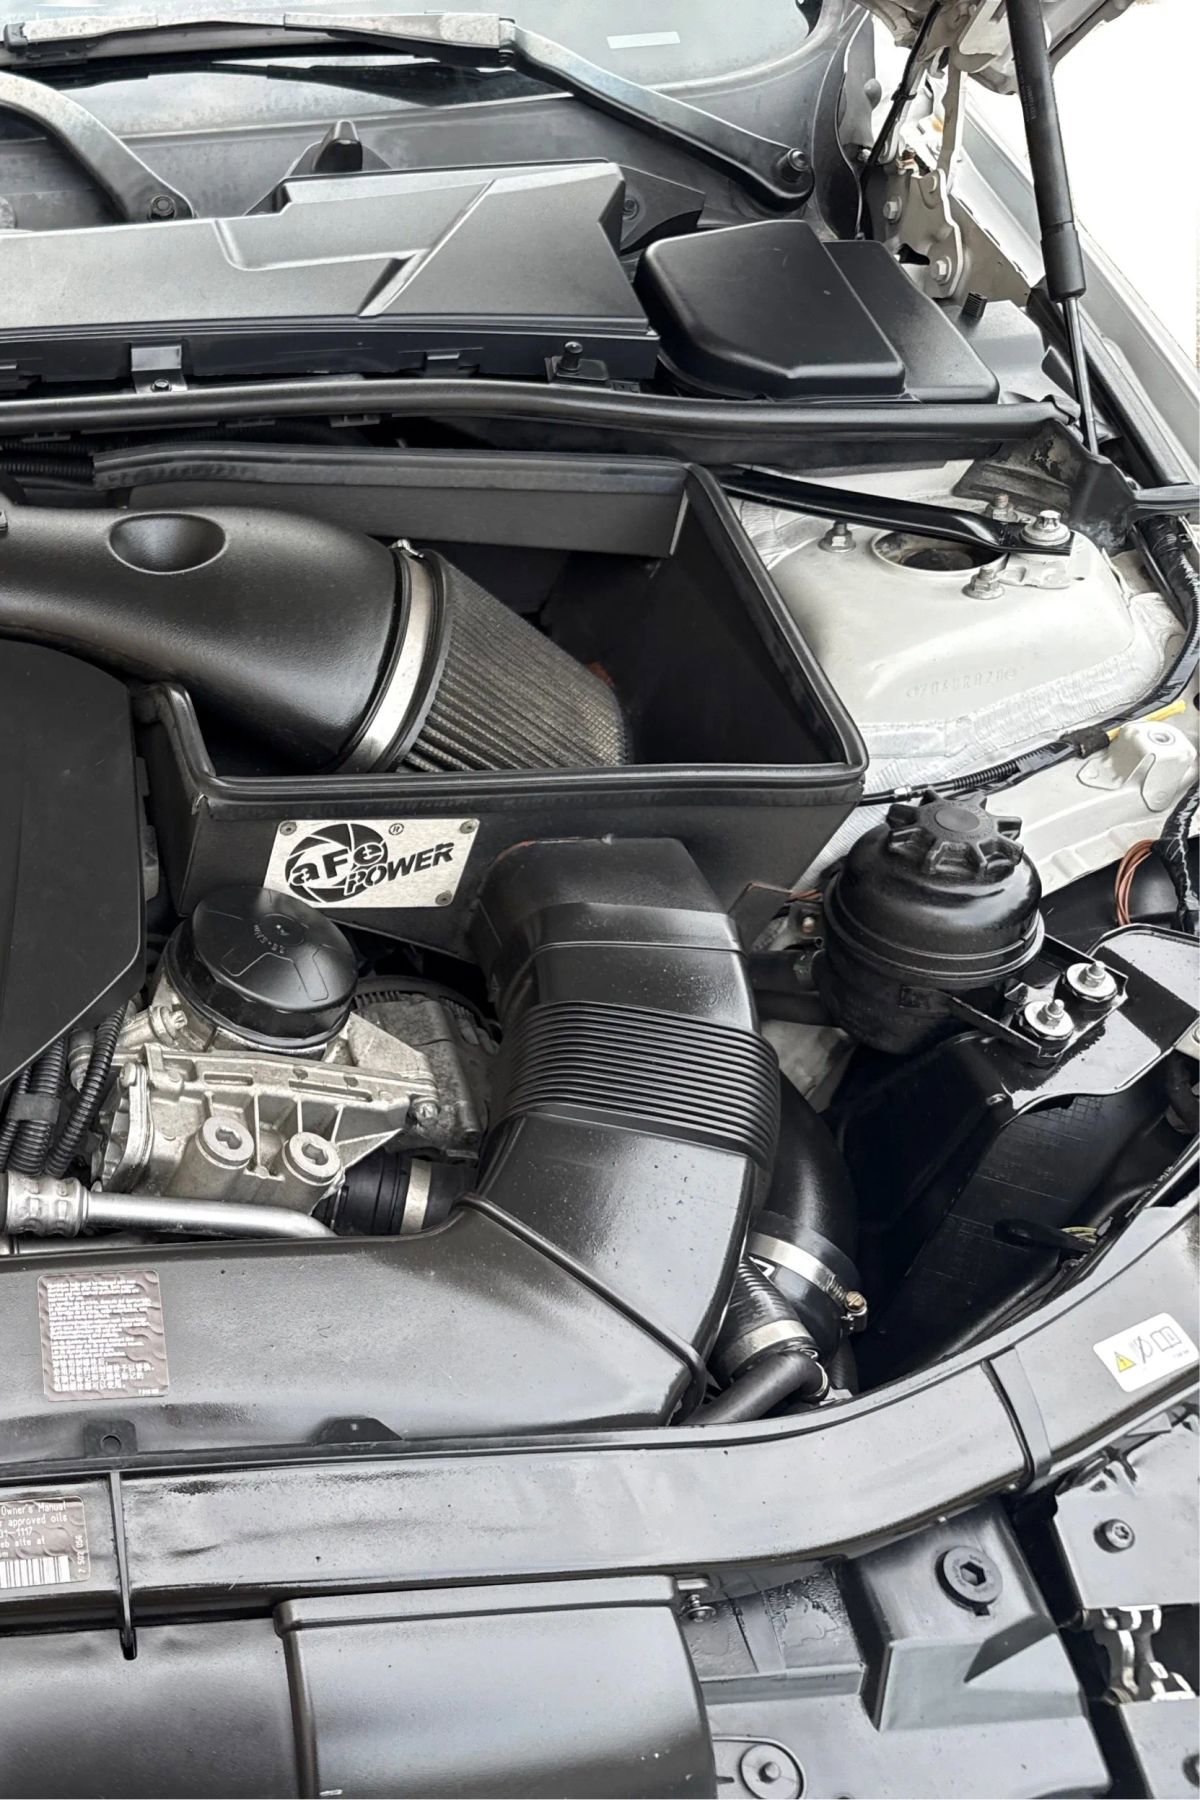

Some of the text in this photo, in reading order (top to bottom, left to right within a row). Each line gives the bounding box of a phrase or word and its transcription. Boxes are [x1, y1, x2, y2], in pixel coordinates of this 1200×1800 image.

[344, 841, 455, 896] POWER
[0, 1503, 33, 1516] Owner's
[37, 1500, 66, 1512] Manual
[7, 1513, 46, 1528] approved
[50, 1511, 68, 1523] oils
[14, 1536, 32, 1547] site
[36, 1535, 46, 1545] at
